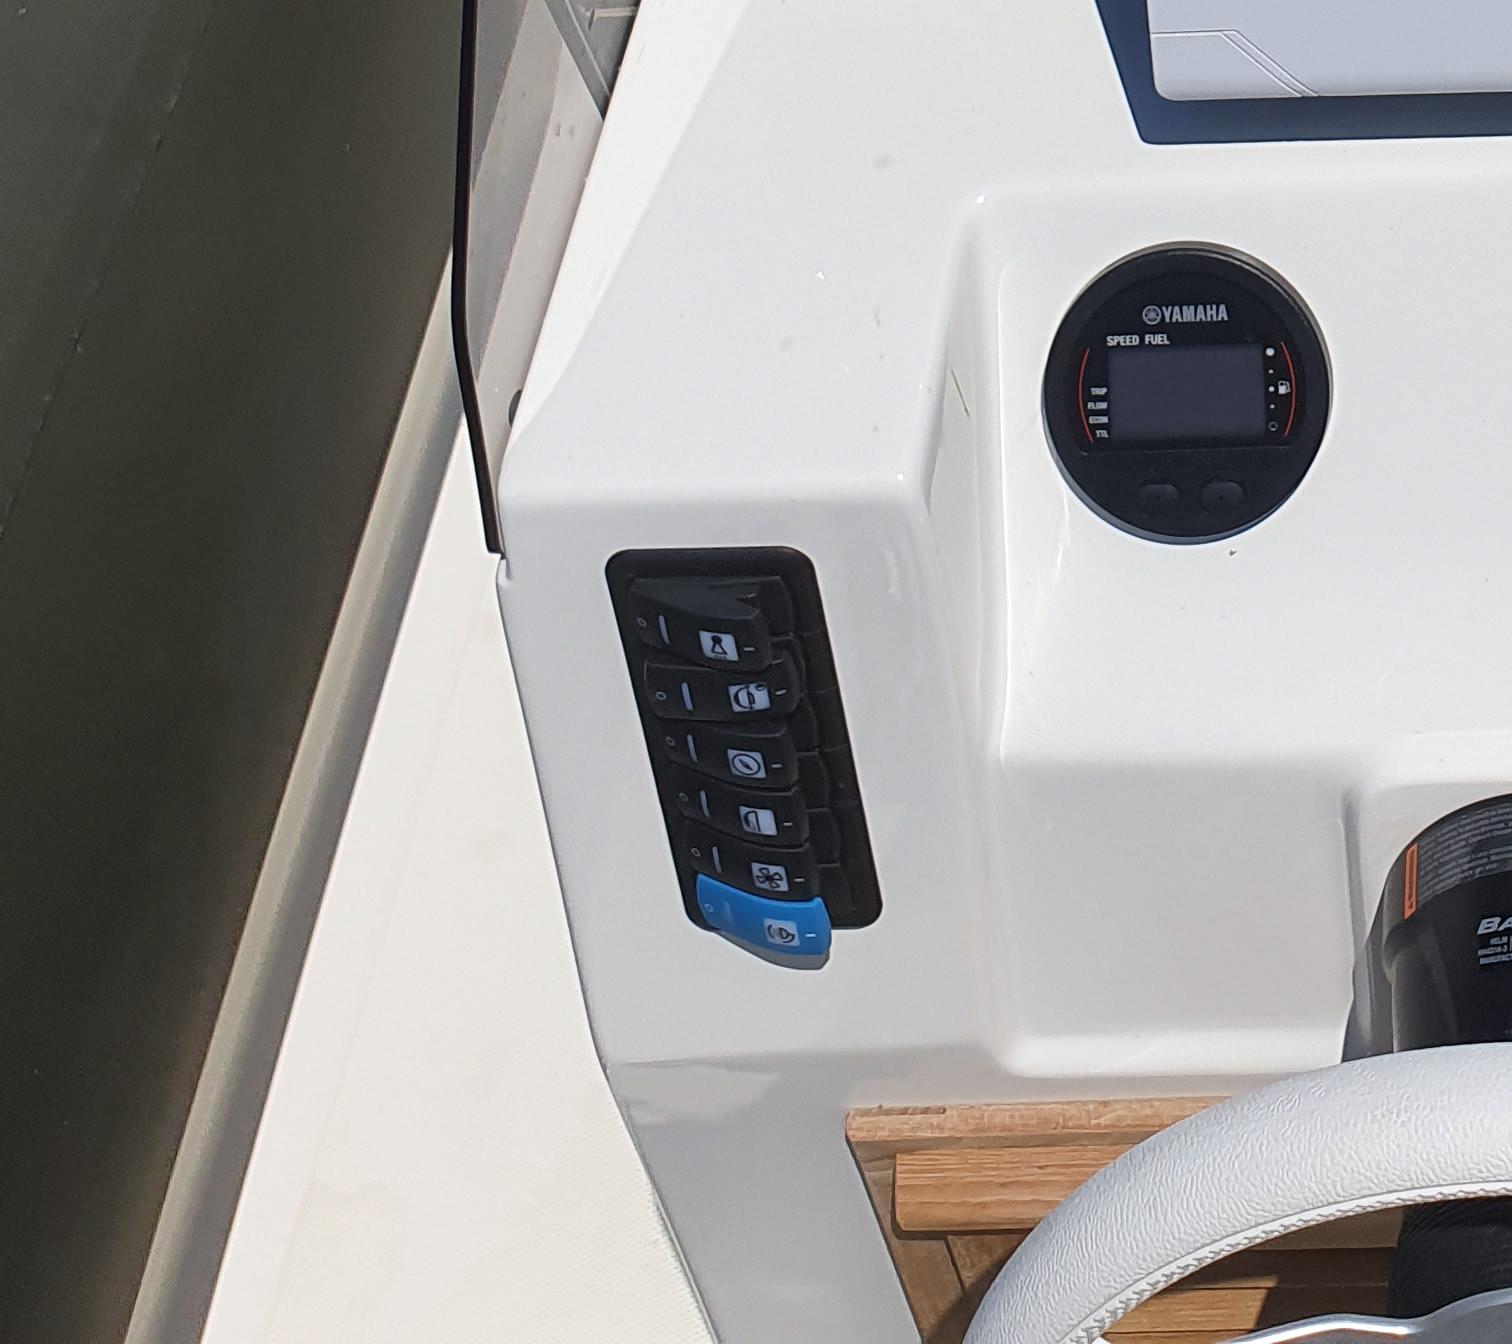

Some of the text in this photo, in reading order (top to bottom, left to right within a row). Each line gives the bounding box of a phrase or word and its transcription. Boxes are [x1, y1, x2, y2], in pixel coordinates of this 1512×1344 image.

[1162, 303, 1229, 323] YAMAHA
[1106, 333, 1170, 347] SPEED FUEL
